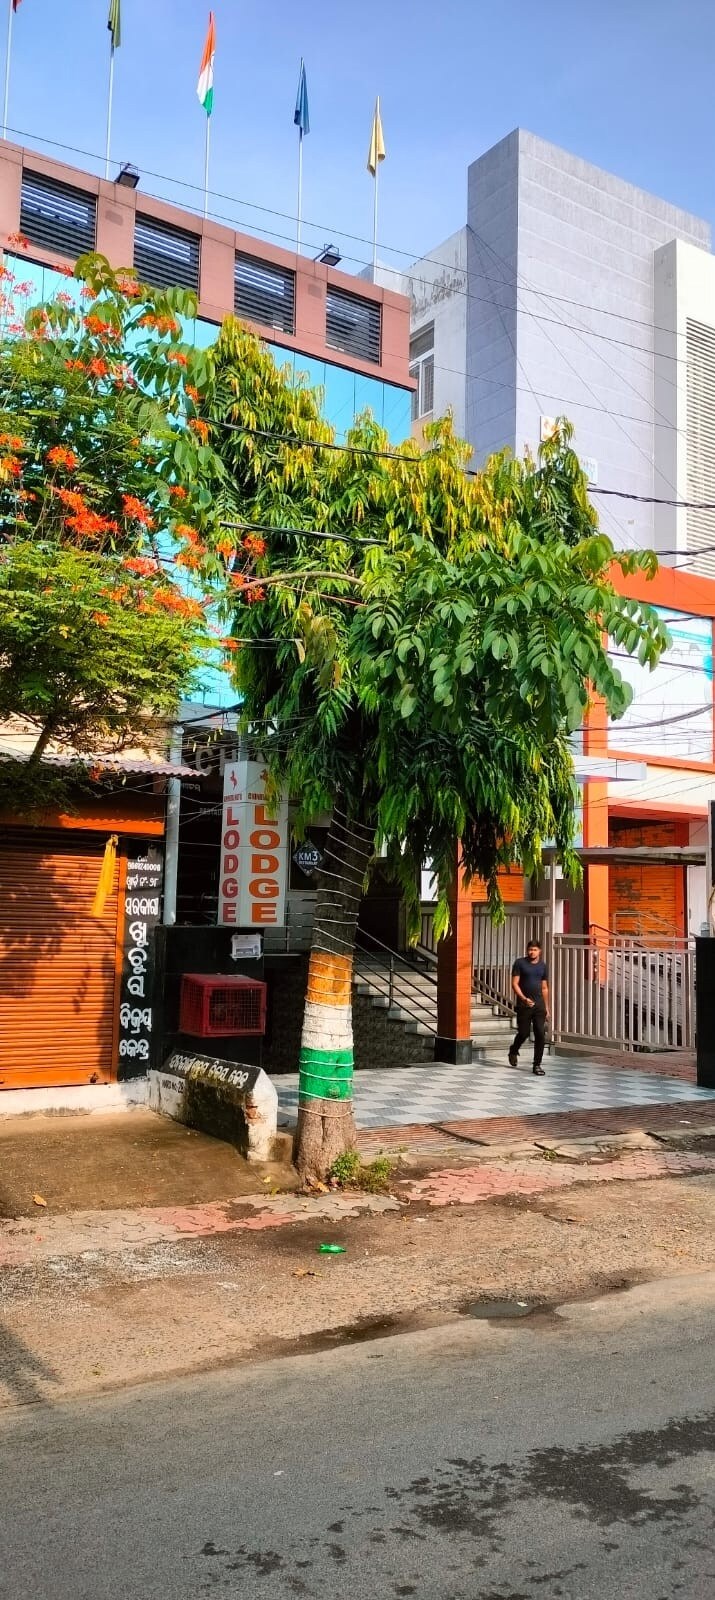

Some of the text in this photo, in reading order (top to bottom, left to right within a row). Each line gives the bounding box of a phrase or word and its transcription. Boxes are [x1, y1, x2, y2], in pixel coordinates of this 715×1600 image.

[222, 806, 240, 923] LODGE
[249, 805, 281, 923] LODGE
[298, 850, 318, 861] KM3
[124, 897, 159, 916] ସରକାରୀ
